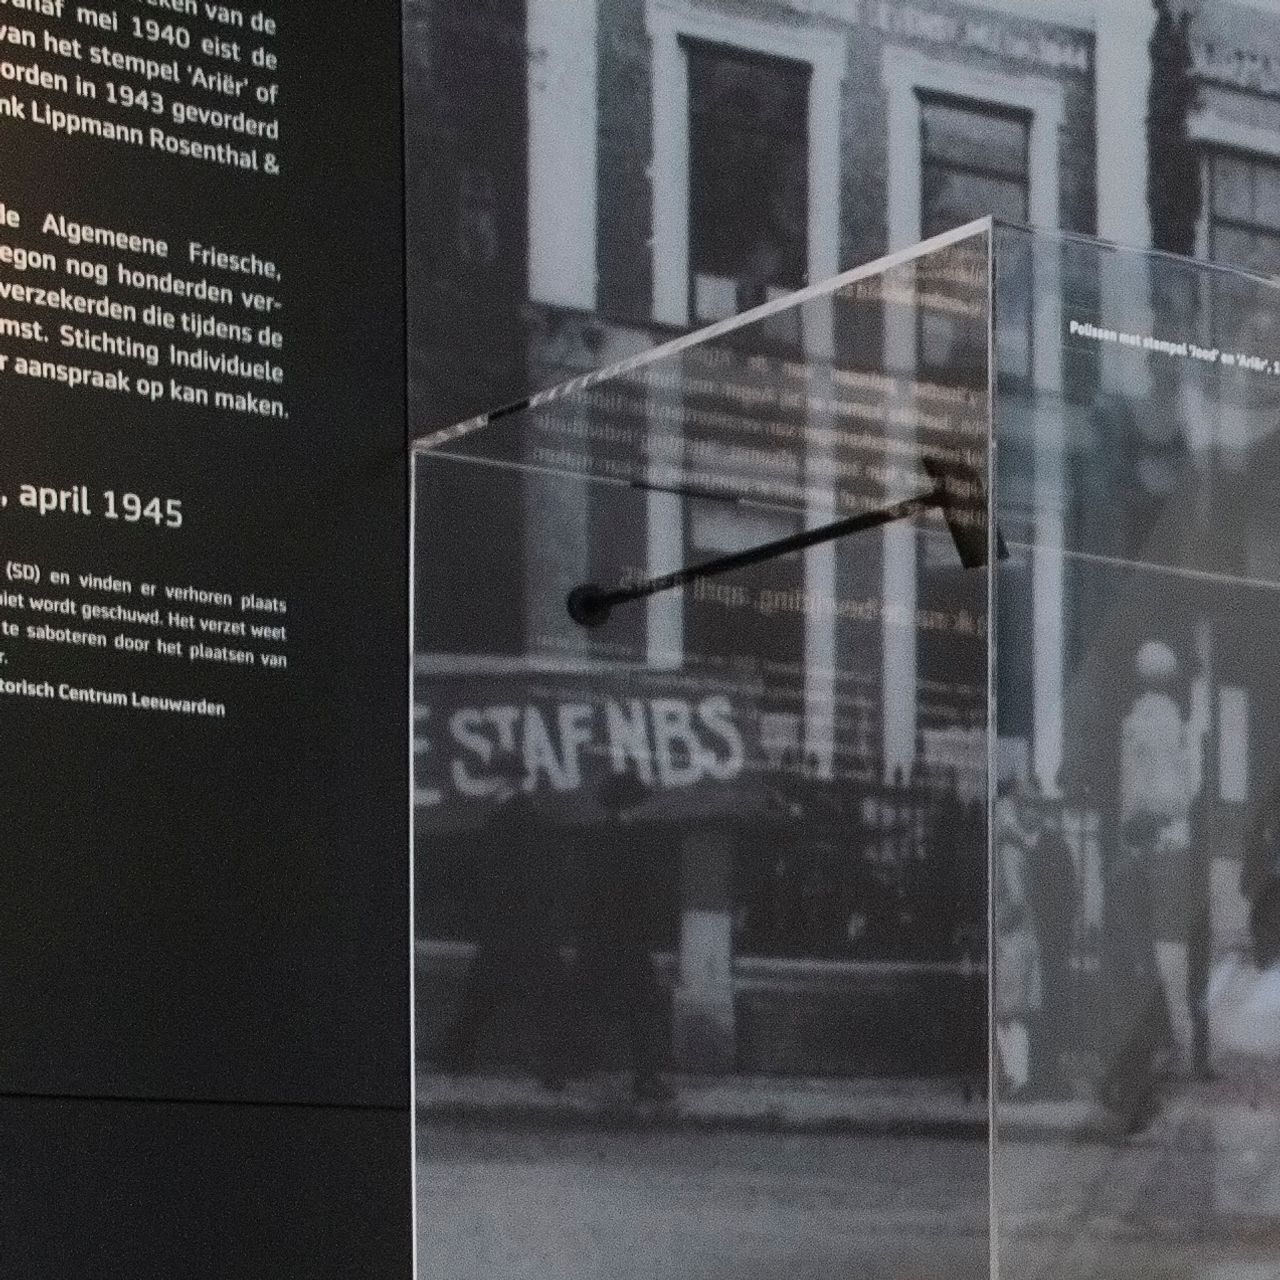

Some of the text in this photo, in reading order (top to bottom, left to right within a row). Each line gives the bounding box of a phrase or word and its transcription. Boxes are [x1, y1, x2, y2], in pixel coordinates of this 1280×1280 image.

[77, 7, 118, 32] mei
[132, 16, 190, 49] 1940
[202, 35, 241, 62] eist
[252, 47, 278, 71] de
[204, 3, 243, 27] van
[251, 10, 276, 35] de
[44, 29, 82, 59] het
[90, 45, 180, 83] stempel
[256, 83, 279, 105] of
[76, 74, 96, 99] in
[105, 82, 163, 115] 1943
[172, 101, 279, 140] gevorderd
[31, 100, 144, 145] Lippmann
[150, 127, 257, 171] Rosenthal
[264, 152, 280, 175] &
[42, 212, 169, 258] Algemeene
[189, 241, 282, 282] Friesche,
[66, 258, 108, 286] nog
[118, 263, 233, 304] honderden
[241, 292, 282, 312] ver-
[0, 281, 283, 349] verzekerden die tijdens de
[60, 324, 159, 366] Stichting
[169, 344, 284, 383] Individuele
[14, 356, 131, 391] aanspraak
[137, 378, 164, 400] op
[170, 379, 208, 406] kan
[215, 389, 289, 419] maken.
[19, 483, 183, 528] april 1945
[6, 561, 287, 614] (SD) en vinden er verhoren plaats
[1, 620, 288, 668] te saboteren door het plaatsen van
[28, 598, 77, 615] wordt
[81, 604, 164, 626] geschuwd.
[168, 610, 196, 630] Het
[200, 618, 247, 637] verzet
[251, 625, 288, 642] weet
[58, 683, 128, 706] Centrum
[131, 691, 226, 718] Leeuwarden
